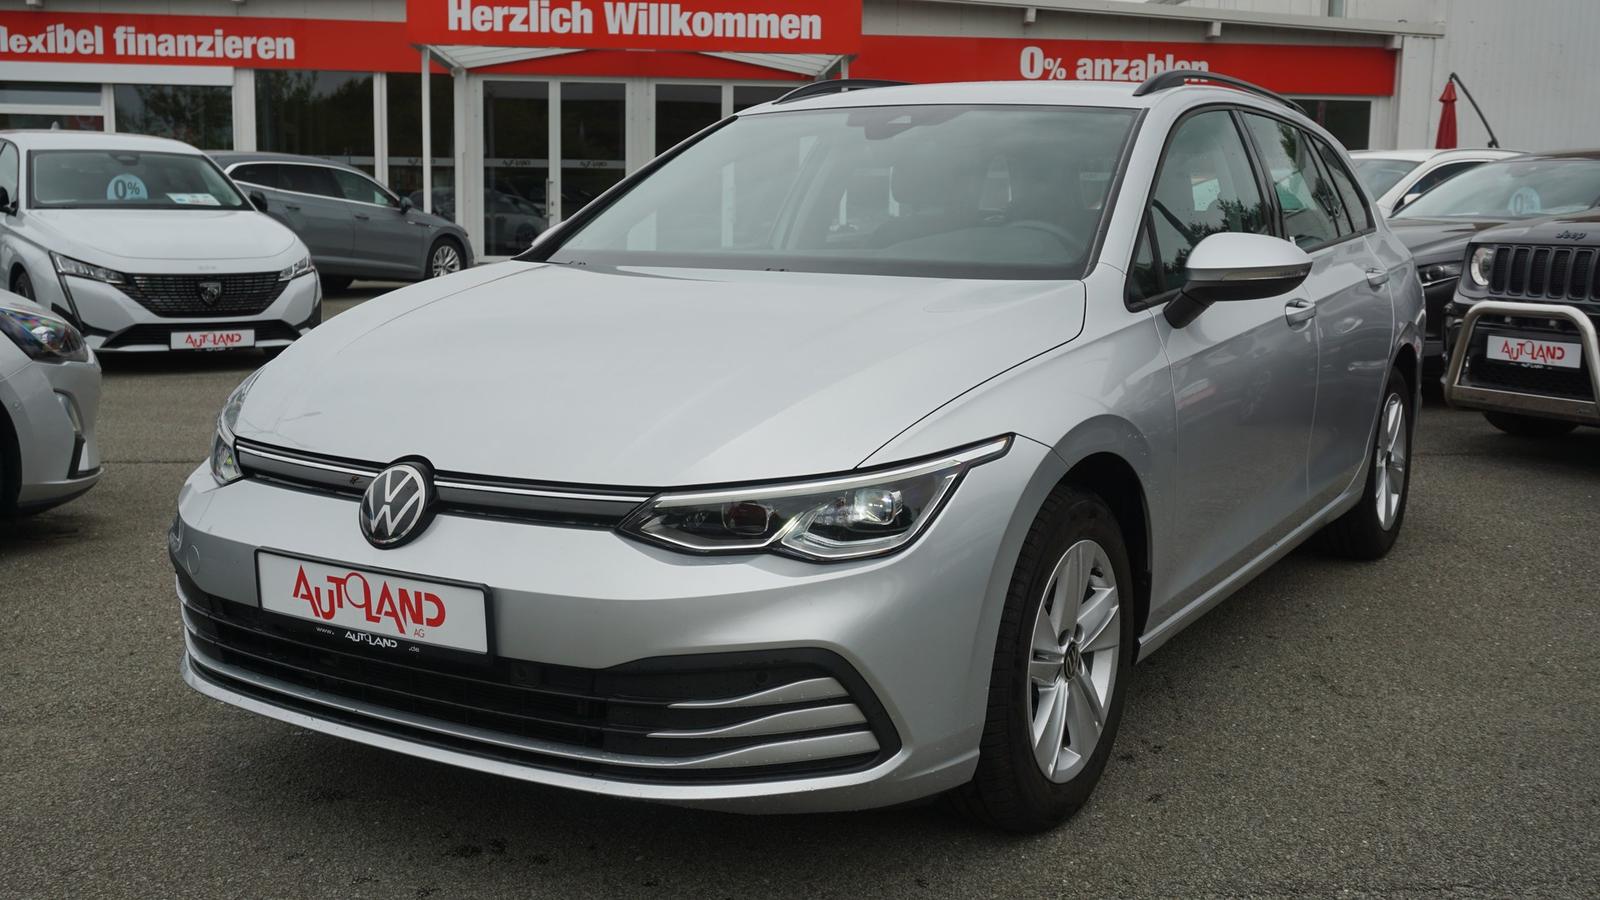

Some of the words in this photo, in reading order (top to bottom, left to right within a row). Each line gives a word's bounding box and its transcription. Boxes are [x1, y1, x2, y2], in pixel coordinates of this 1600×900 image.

[448, 0, 593, 35] Herzlich
[604, 2, 822, 40] Willkommen
[113, 26, 296, 61] finanzieren
[1019, 46, 1067, 81] 0%
[113, 179, 141, 199] 0%
[1555, 229, 1588, 241] Jeep
[1501, 339, 1566, 364] AUTOLAND
[293, 564, 446, 635] AUTOLAND
[344, 631, 398, 649] AUTOLAND
[413, 628, 425, 638] AG
